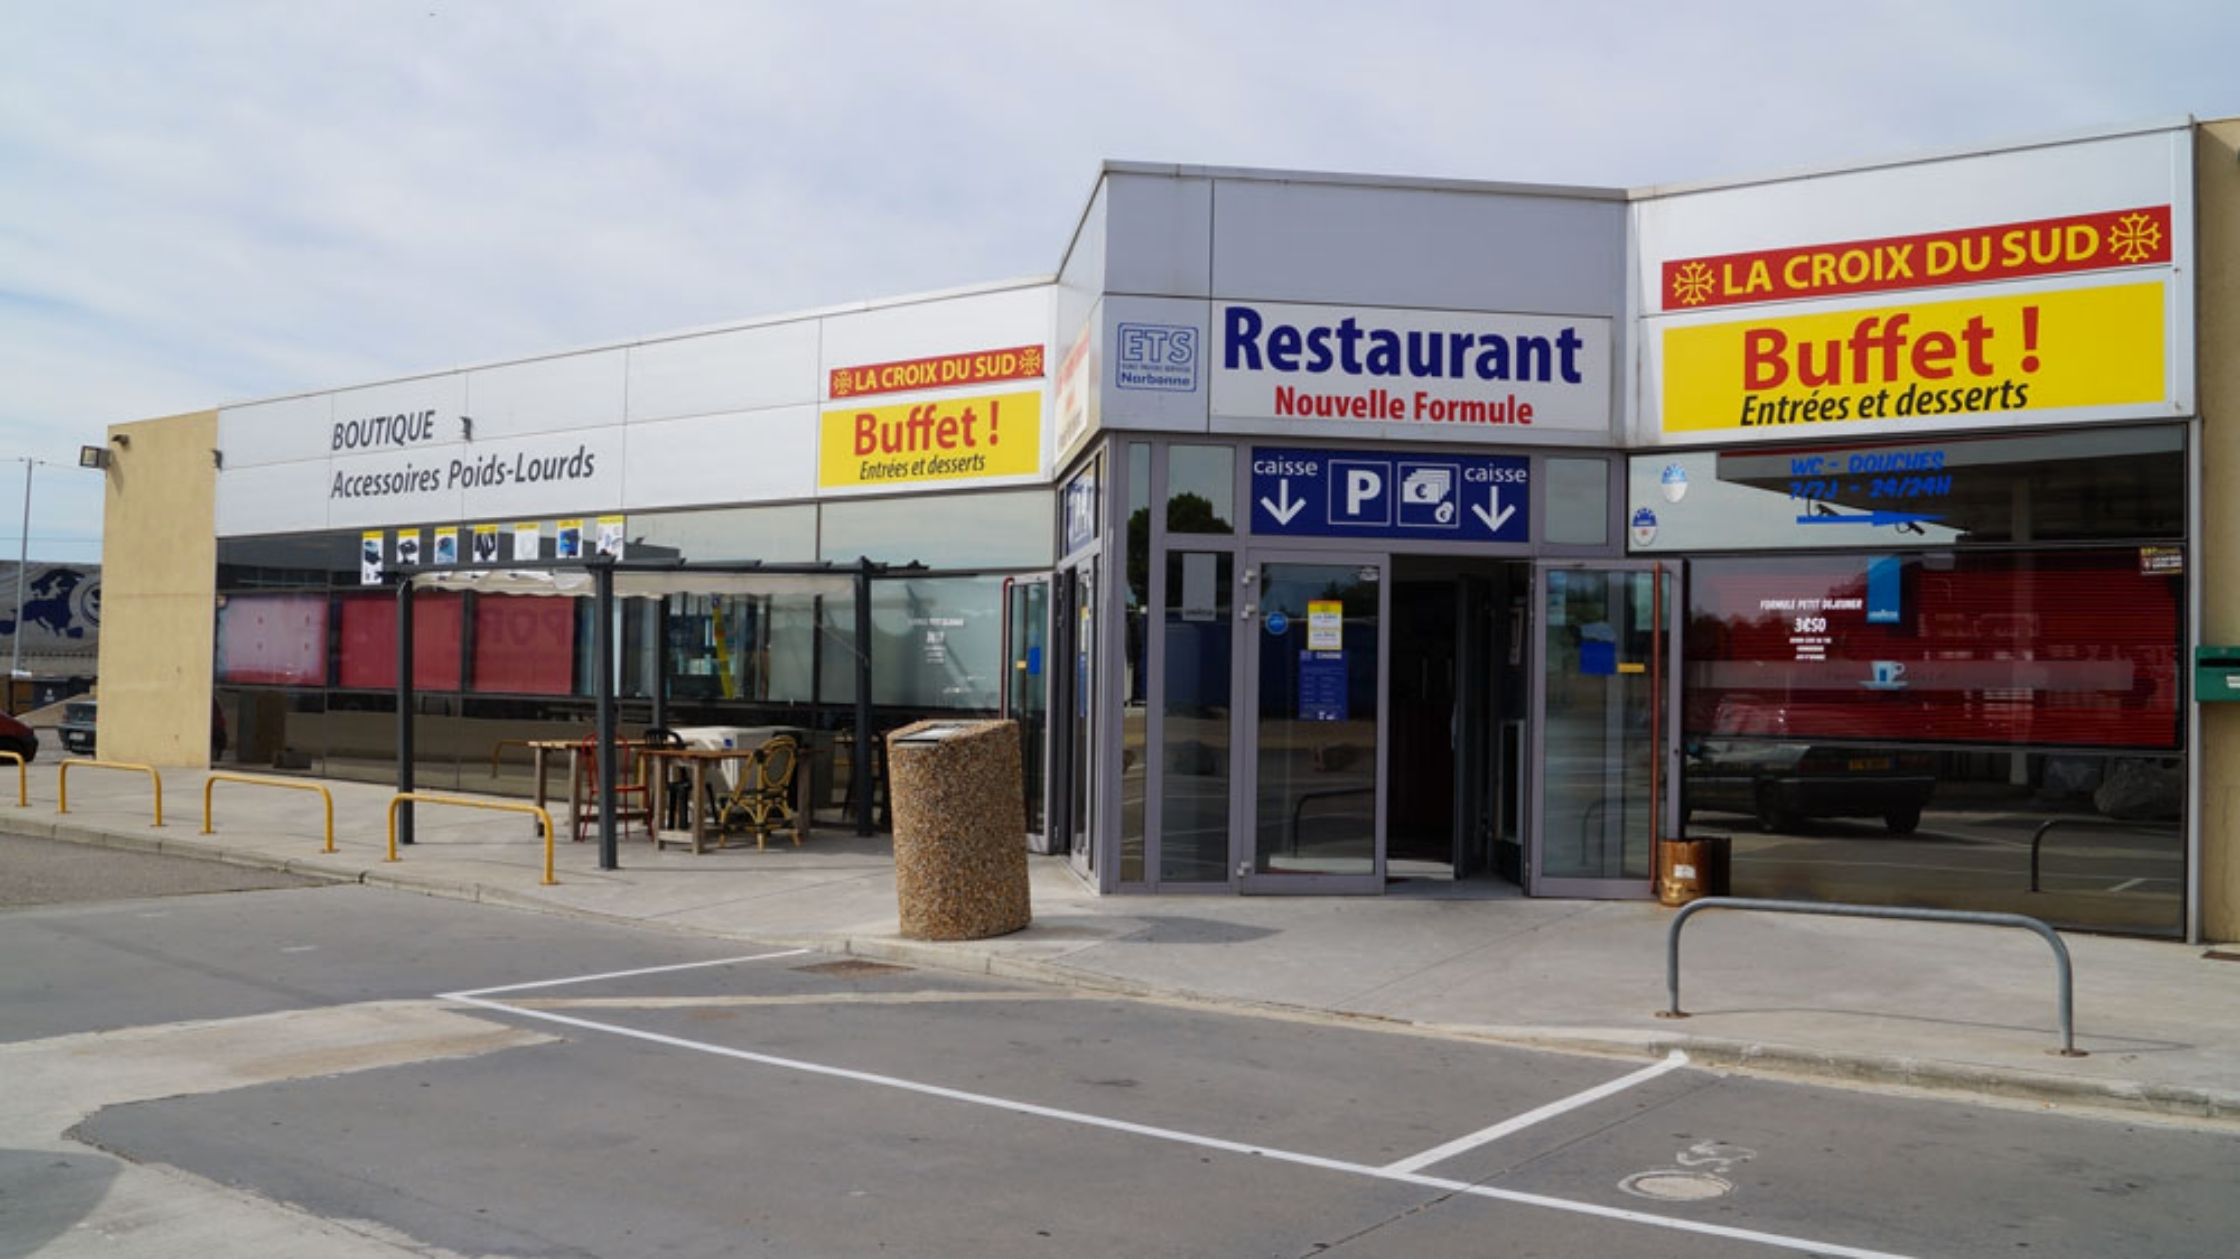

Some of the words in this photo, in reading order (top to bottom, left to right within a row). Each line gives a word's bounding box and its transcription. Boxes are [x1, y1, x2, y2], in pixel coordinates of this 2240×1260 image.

[1723, 260, 1773, 297] LA
[1783, 244, 1915, 290] CROIX
[1926, 235, 1993, 276] DU
[2002, 225, 2100, 267] SUD
[1122, 329, 1193, 364] ETS
[1224, 306, 1583, 384] Restaurant
[1743, 313, 1995, 392] Buffet
[2021, 305, 2041, 374] !
[855, 368, 878, 392] LA
[882, 363, 938, 388] CROIX
[942, 358, 971, 382] DU
[975, 353, 1016, 378] SUD
[1122, 372, 1190, 386] Narbonne
[1275, 386, 1406, 420] Nouvelle
[1413, 391, 1534, 425] Formule
[1740, 389, 1850, 427] Entrées
[1857, 391, 1887, 420] et
[1895, 380, 2029, 417] desserts
[332, 410, 435, 451] BOUTIQUE
[854, 404, 977, 456] Buffet
[988, 400, 999, 446] !
[331, 464, 441, 499] Accessoires
[448, 444, 595, 490] Poids-Lourds
[860, 459, 908, 481] Entrées
[911, 457, 924, 476] et
[927, 453, 986, 474] desserts
[1254, 457, 1318, 478] caisse
[1464, 463, 1529, 483] caisse
[1791, 457, 1825, 476] WC
[1847, 451, 1945, 474] DOUCHES
[1346, 469, 1381, 515] P
